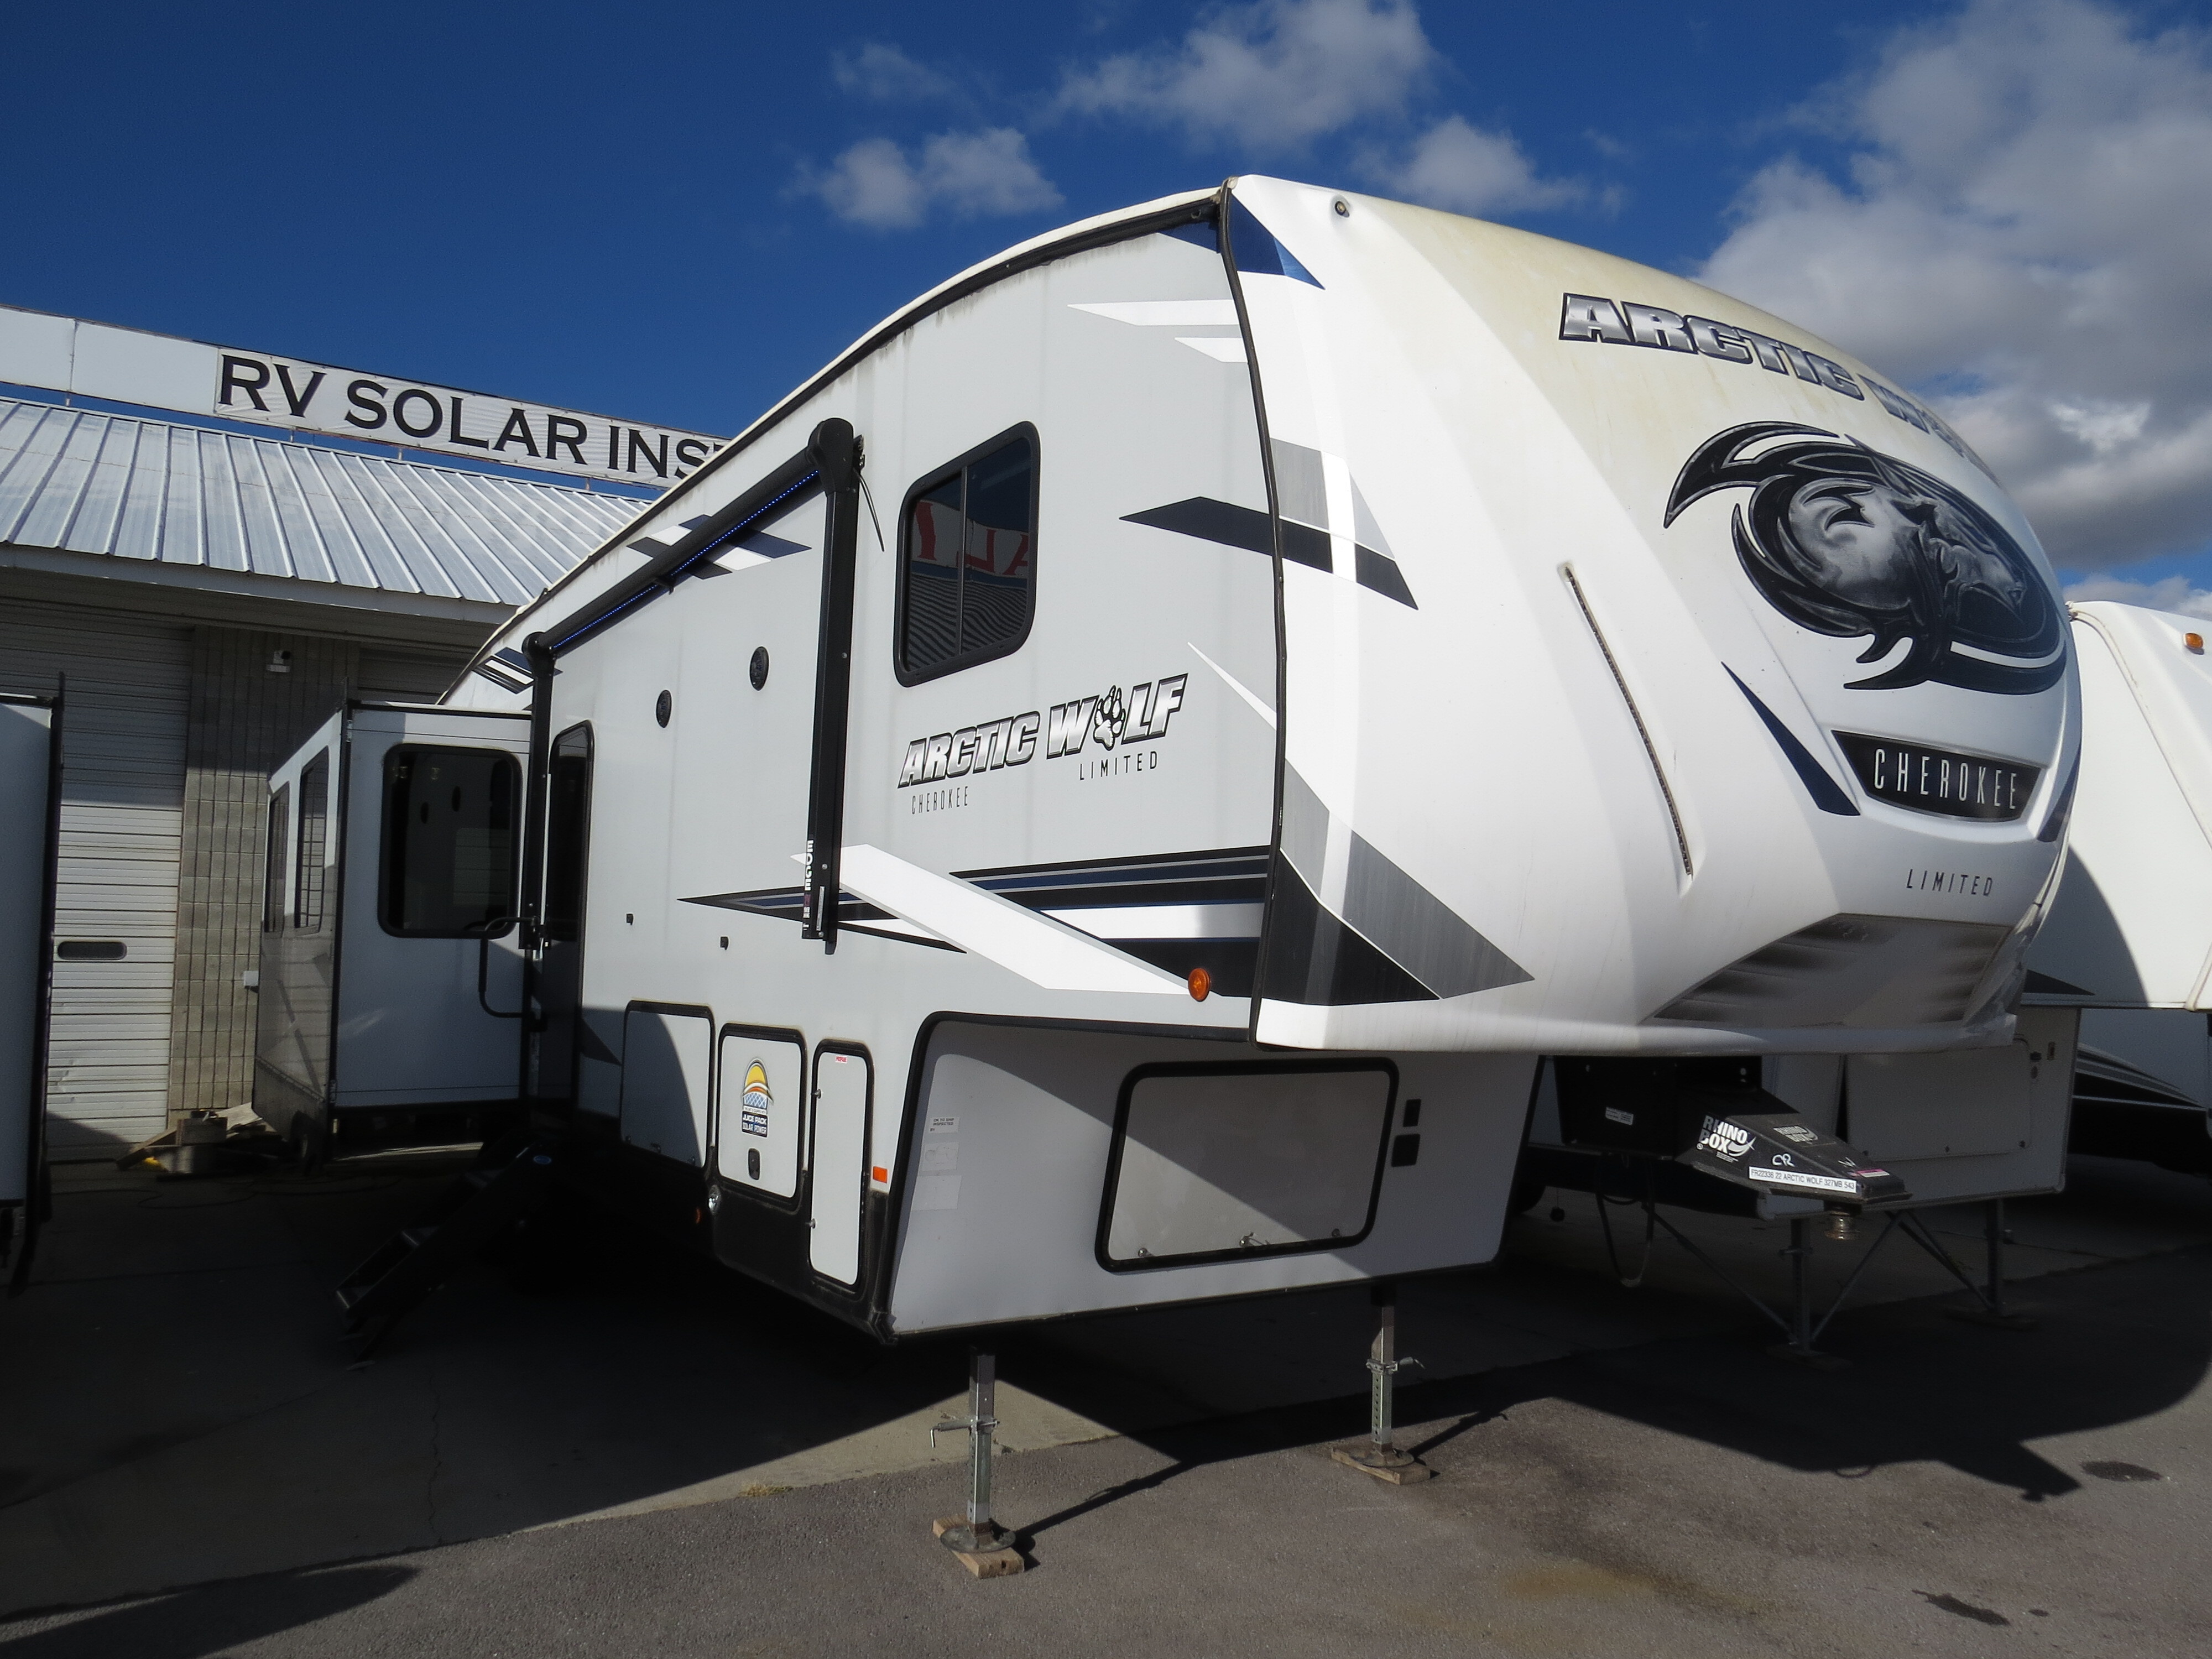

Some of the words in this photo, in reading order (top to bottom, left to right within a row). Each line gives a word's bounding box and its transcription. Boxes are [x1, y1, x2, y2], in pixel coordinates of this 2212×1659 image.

[1559, 293, 1864, 400] ARCTIC
[219, 355, 326, 418] RV
[345, 379, 588, 466] SOLAR
[608, 425, 724, 479] INS
[898, 711, 1040, 787] ARCTIC
[1079, 750, 1157, 780] LIMITED
[1874, 748, 2017, 810] CHEROKEE
[911, 786, 968, 815] CHEROKEE
[805, 840, 813, 891] EDGE
[1906, 869, 1993, 896] LIMITED
[1698, 1128, 1730, 1154] BOX
[1703, 1115, 1747, 1144] RHINO
[1783, 1173, 1804, 1182] ARCTIC
[1806, 1176, 1823, 1185] WOLF
